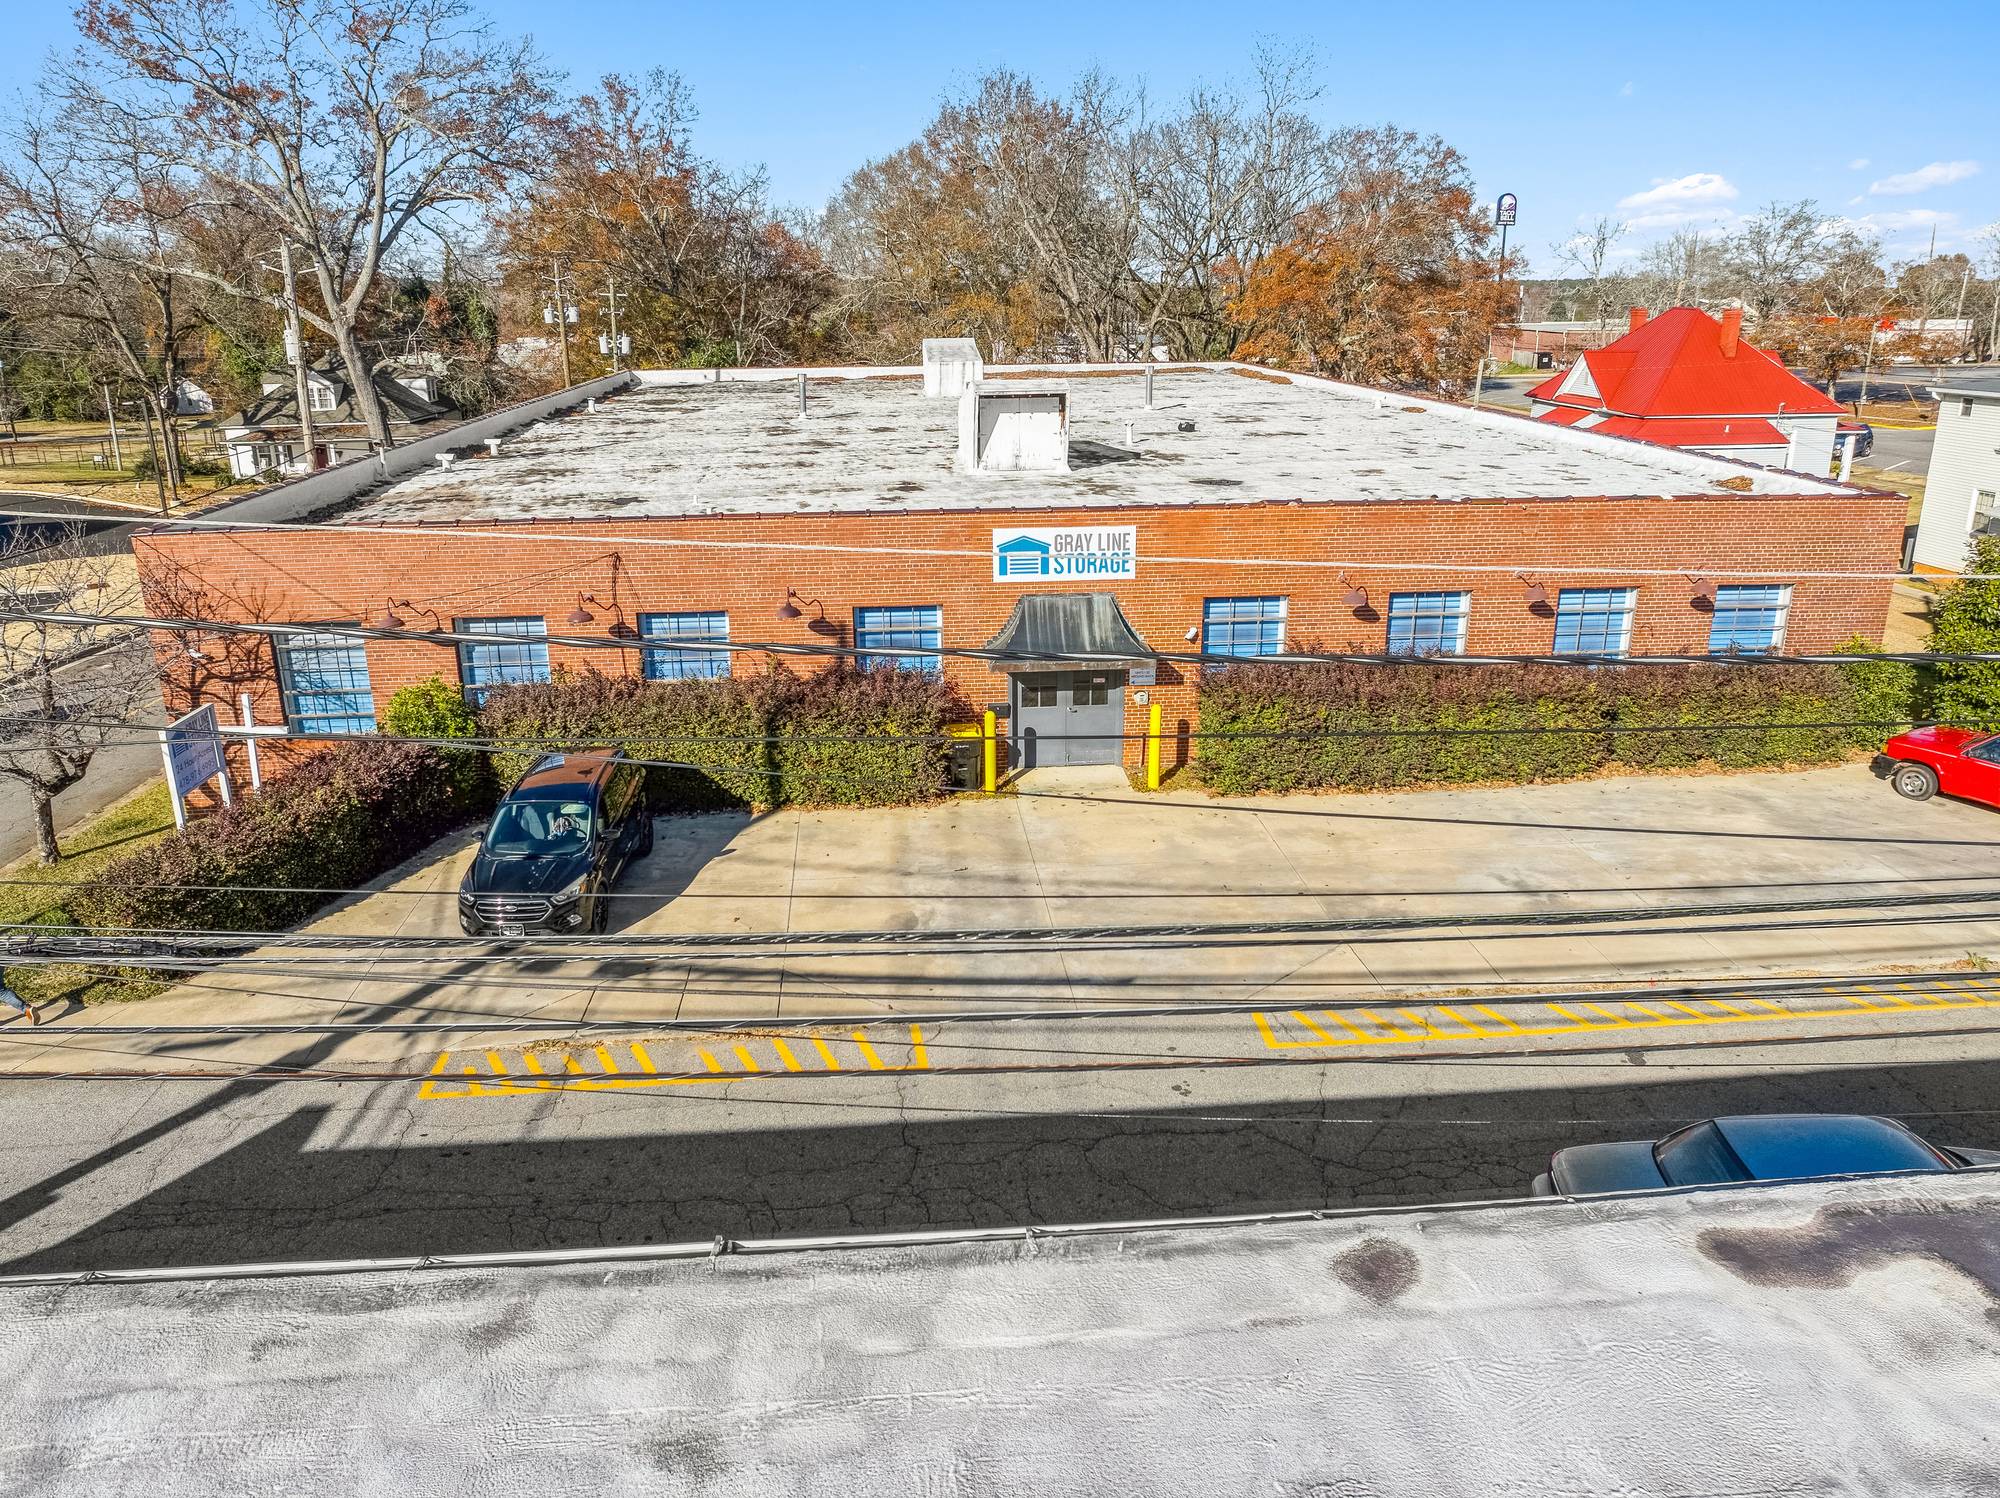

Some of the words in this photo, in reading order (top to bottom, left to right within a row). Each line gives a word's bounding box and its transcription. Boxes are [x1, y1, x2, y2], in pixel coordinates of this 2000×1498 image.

[1054, 533, 1093, 553] GRAY
[1098, 532, 1130, 552] LINE
[1053, 552, 1131, 574] STORAGE
